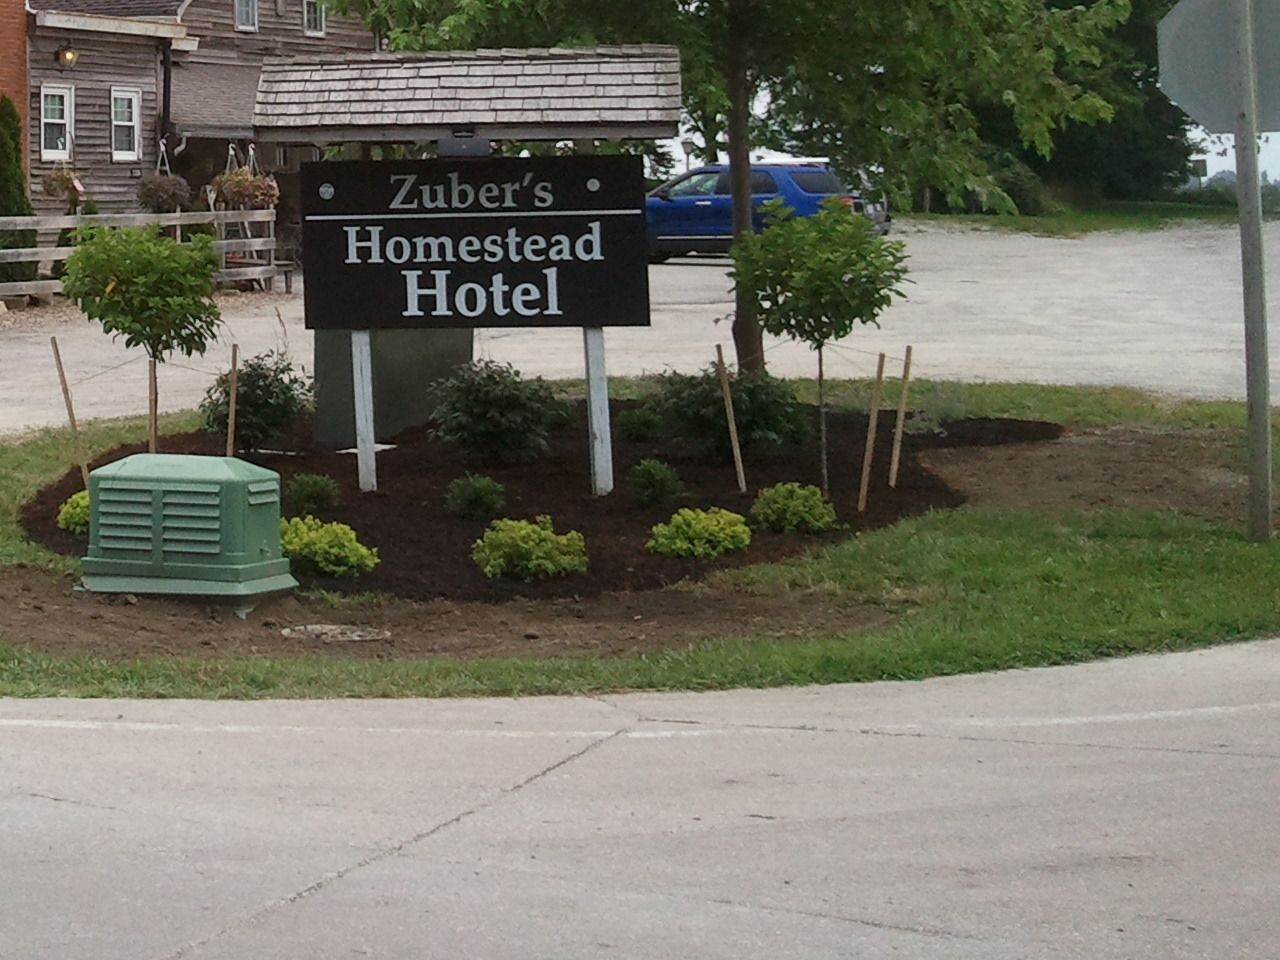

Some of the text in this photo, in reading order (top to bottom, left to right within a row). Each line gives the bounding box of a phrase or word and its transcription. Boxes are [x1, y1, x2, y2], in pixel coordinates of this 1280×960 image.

[388, 172, 554, 210] Zuber's
[342, 221, 605, 264] Homestead
[401, 267, 563, 317] Hotel
